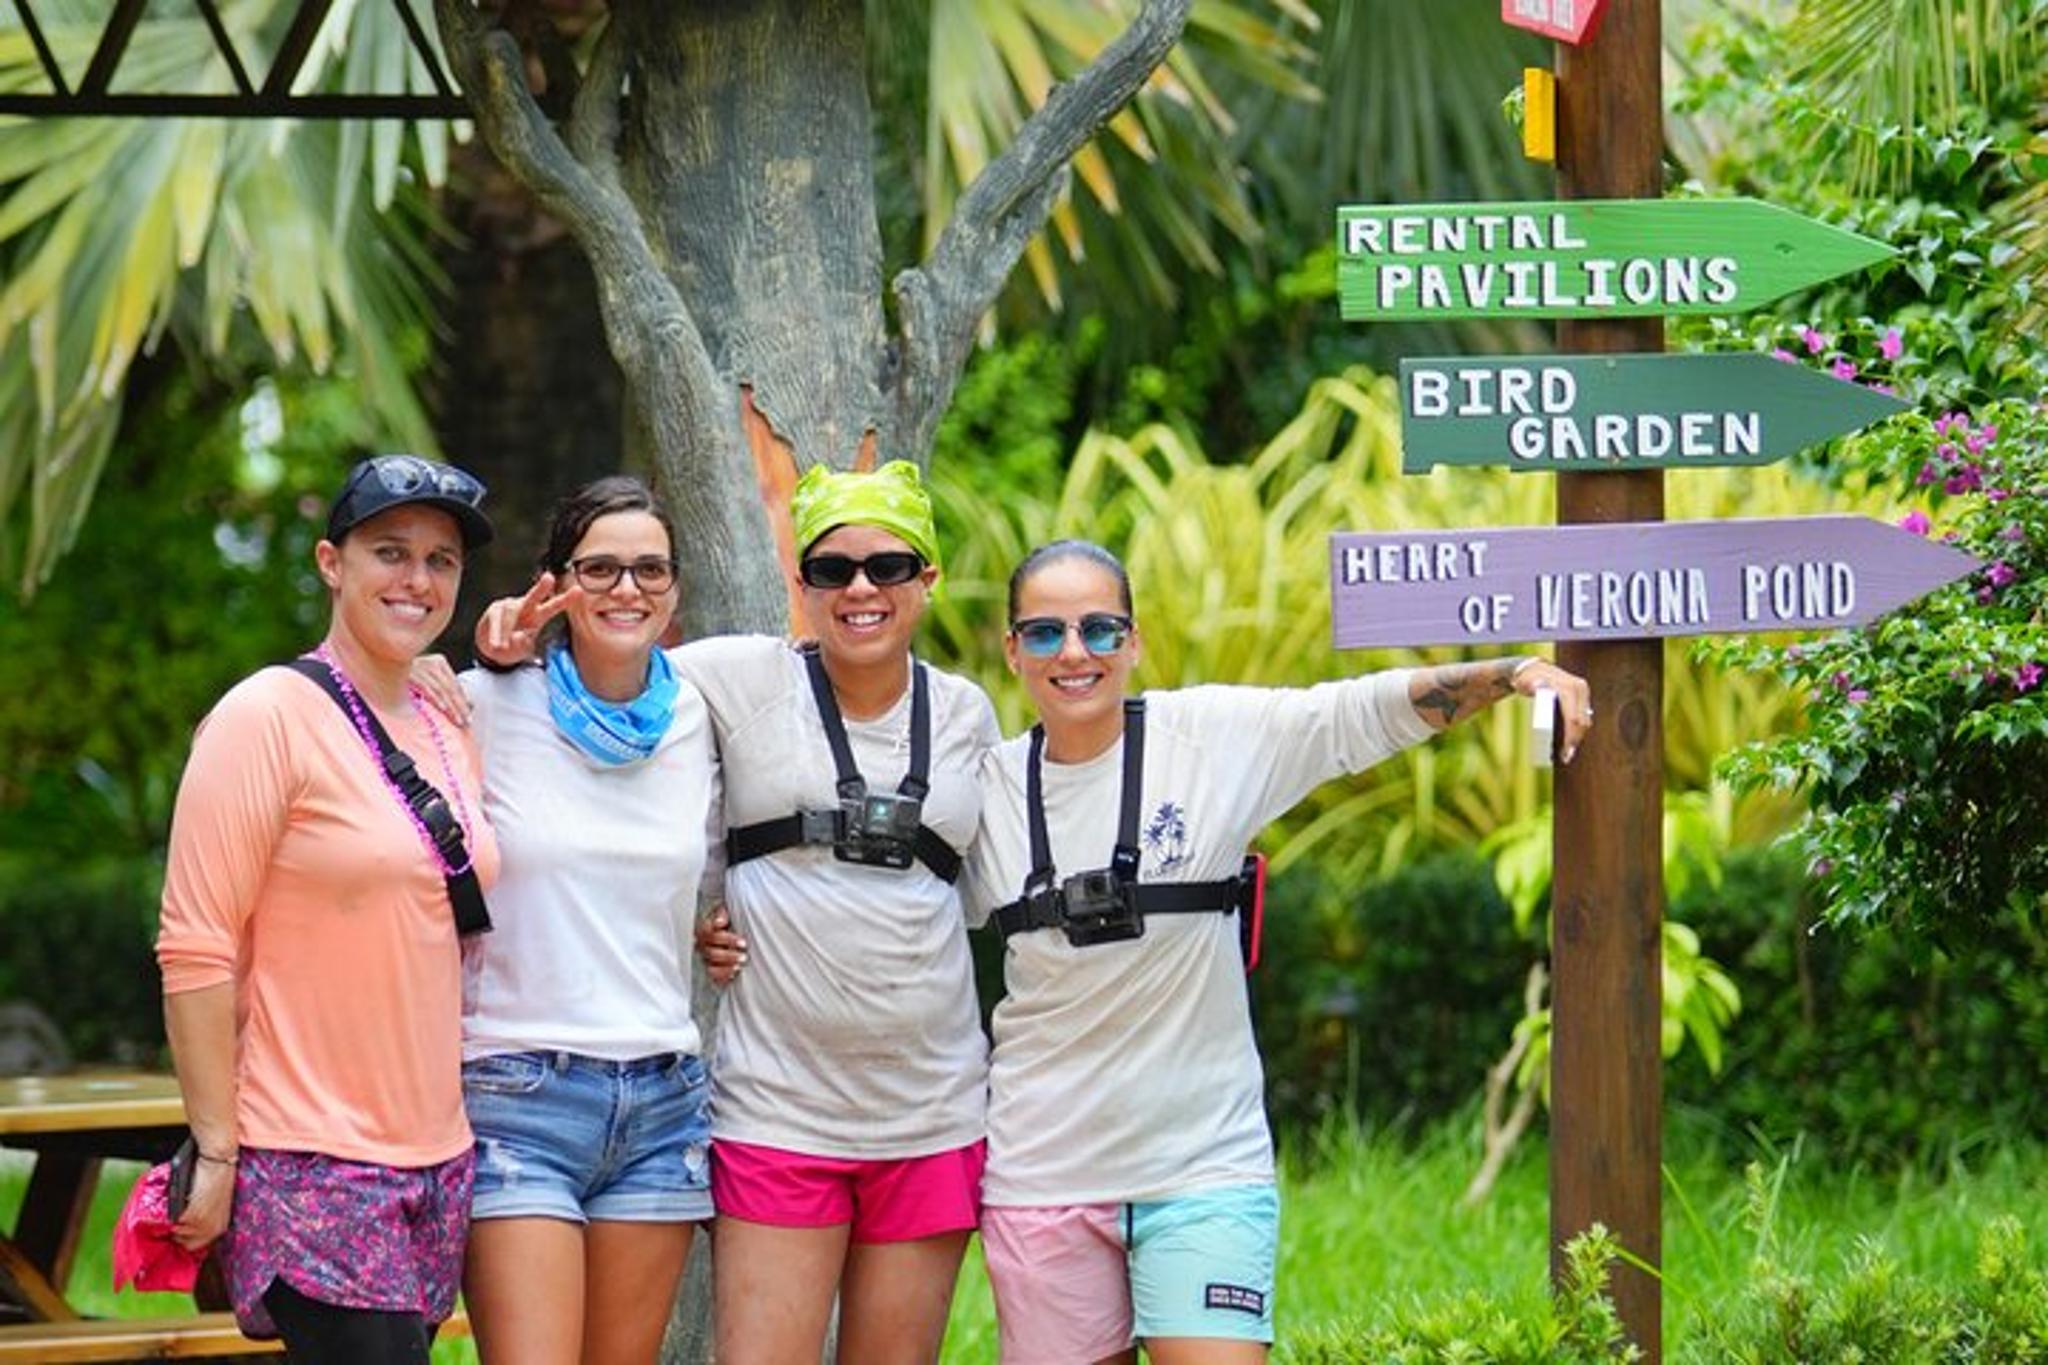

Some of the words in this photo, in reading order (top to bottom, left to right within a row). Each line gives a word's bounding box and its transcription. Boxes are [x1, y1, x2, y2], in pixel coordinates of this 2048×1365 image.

[1346, 215, 1586, 253] RENTAL
[1377, 258, 1738, 308] PAVILIONS
[1410, 368, 1577, 417] BIRD
[1509, 412, 1760, 459] GARDEN
[1343, 540, 1488, 583] HEART
[1460, 595, 1514, 633] OF
[1537, 568, 1709, 629] VERONA
[1743, 562, 1856, 620] POND
